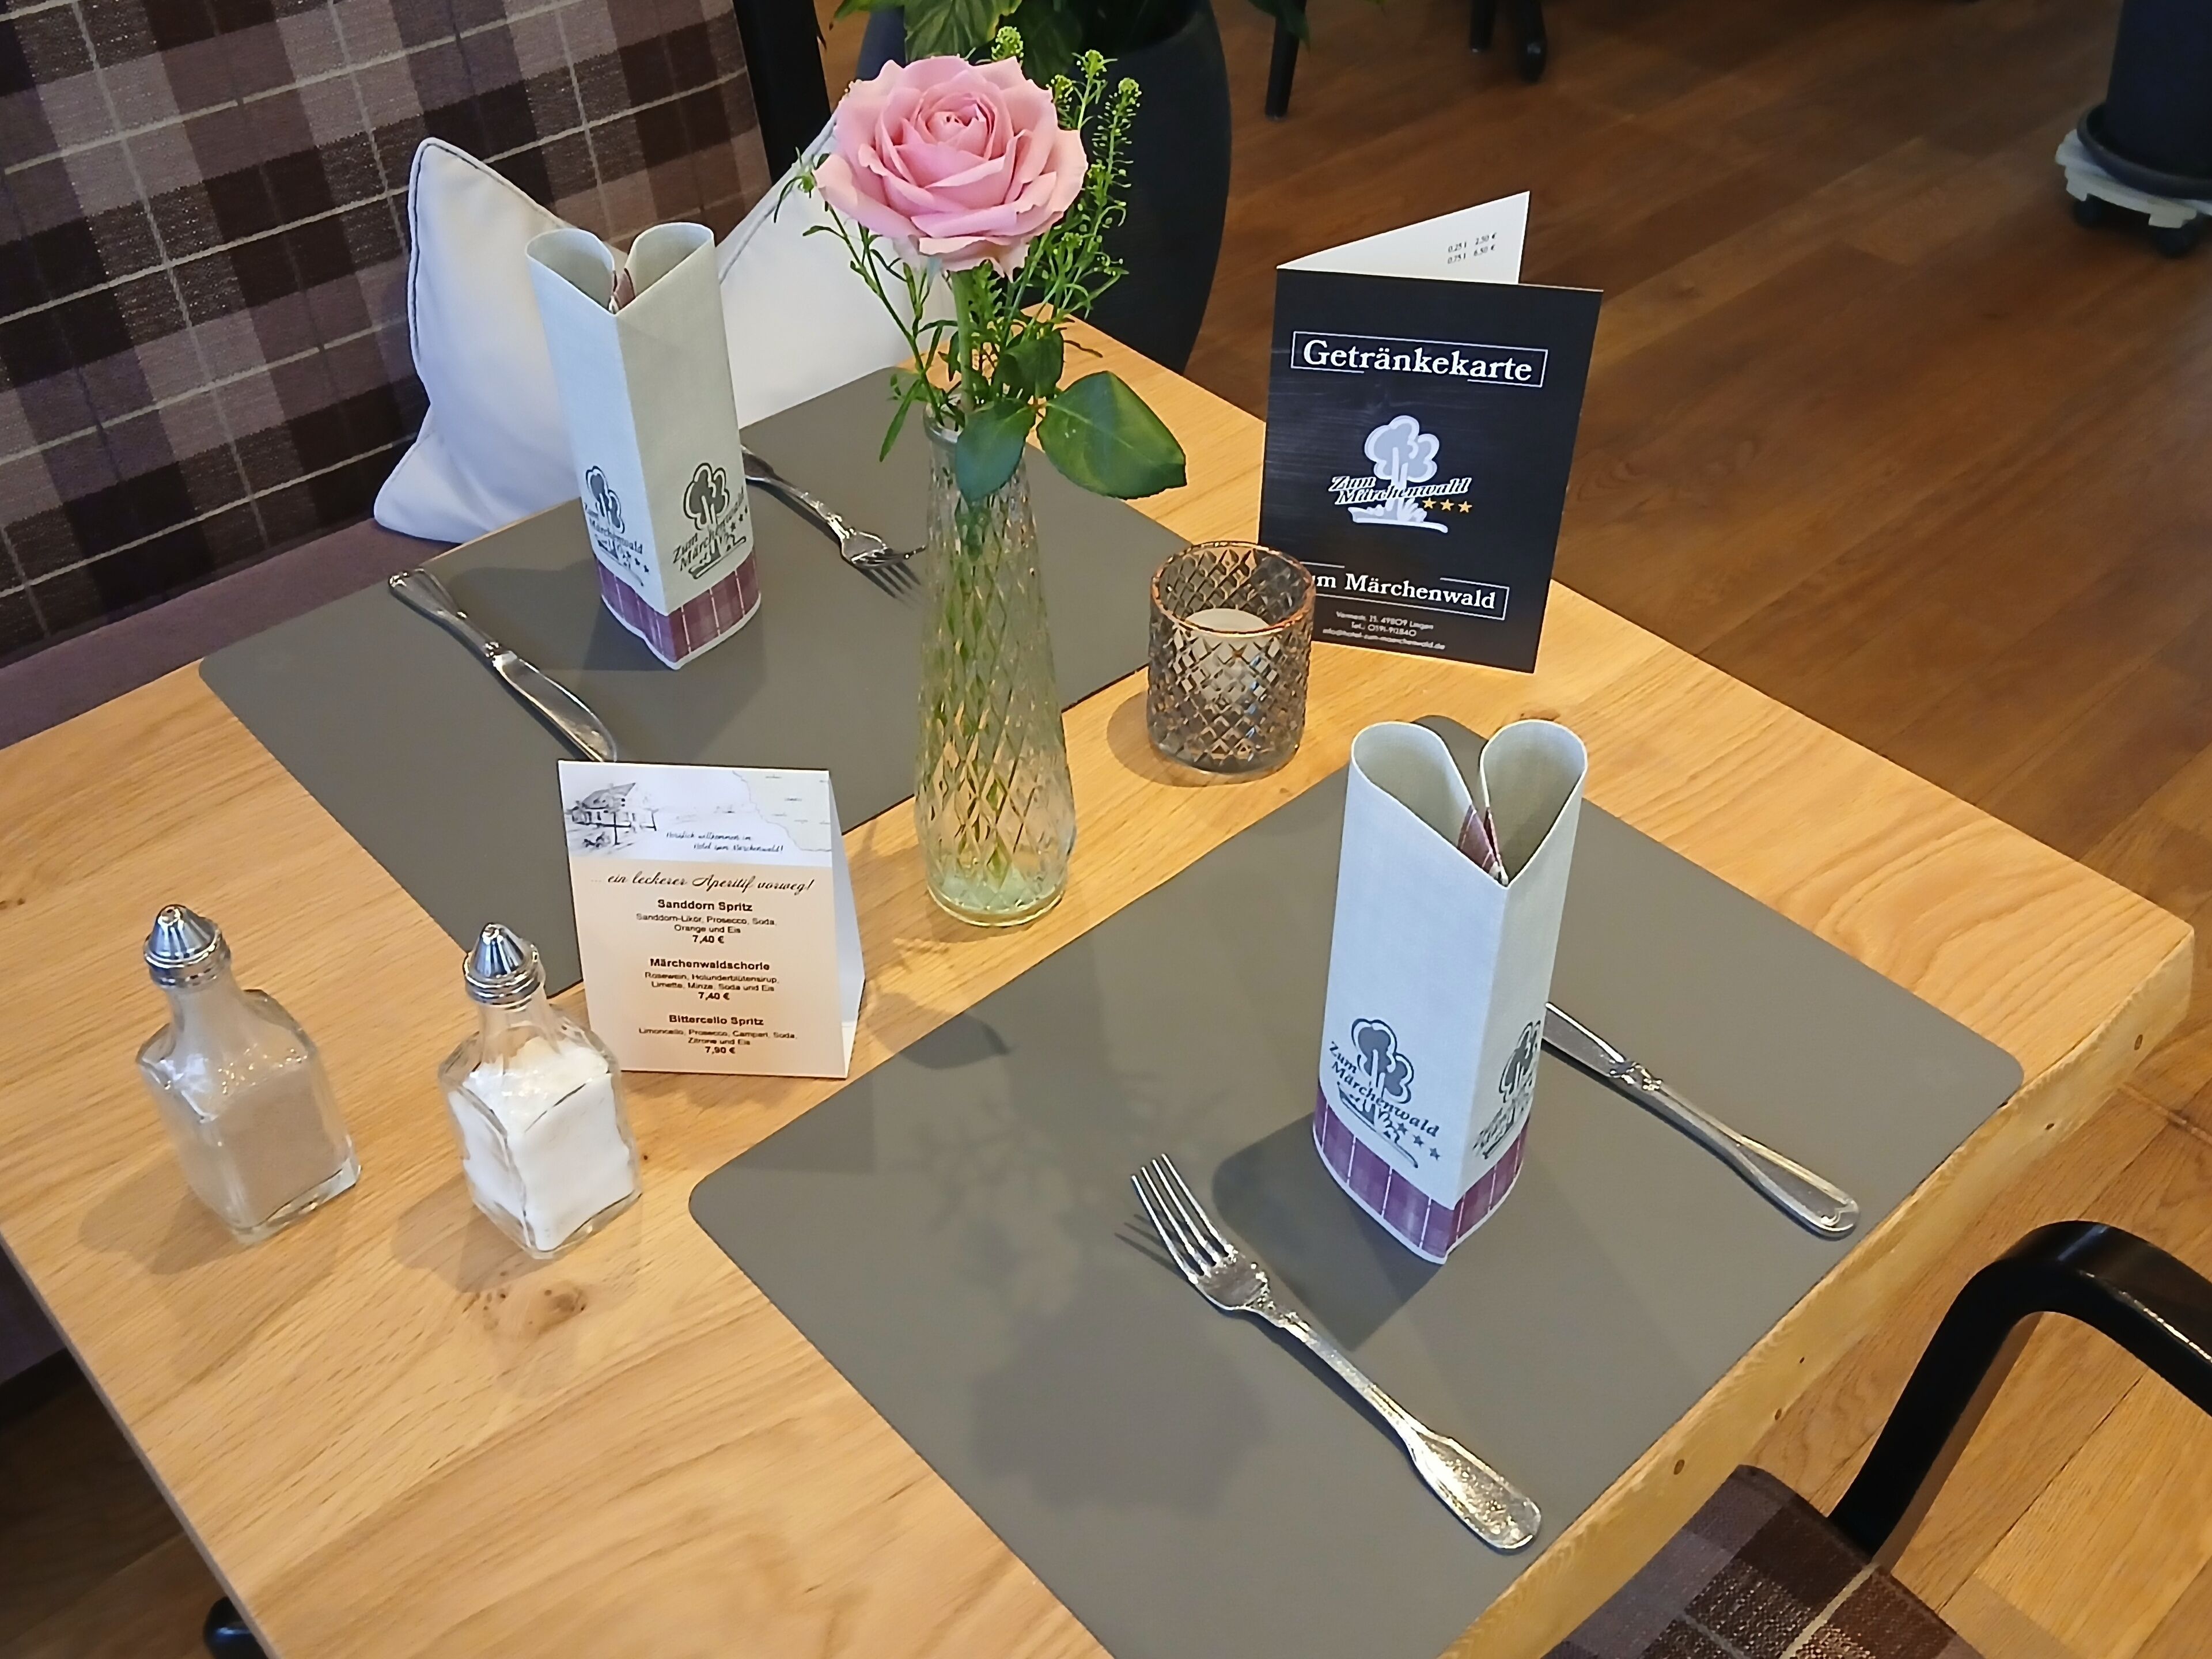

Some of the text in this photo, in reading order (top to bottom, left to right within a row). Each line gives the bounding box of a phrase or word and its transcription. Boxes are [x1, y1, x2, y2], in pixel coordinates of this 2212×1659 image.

[1304, 340, 1532, 381] Getränkekarte
[1328, 476, 1377, 491] Zum
[1335, 478, 1472, 505] Märchenwald
[1344, 573, 1495, 609] Märchenwald
[608, 874, 627, 883] ein
[632, 871, 687, 886] leckerer
[692, 874, 755, 893] Aperitif
[757, 879, 815, 895] vorweg!
[657, 899, 753, 912] Sanddorn Spritz
[707, 916, 749, 925] Prosecco,
[674, 925, 706, 933] Orange
[692, 935, 714, 944] 7,40
[650, 959, 770, 970] Märchenwaldschorle
[698, 992, 720, 1001] 7,40
[669, 1015, 764, 1027] Bittercello Spritz
[704, 1046, 727, 1054] 7,90
[1329, 1041, 1357, 1074] Zum
[1331, 1061, 1440, 1137] Märchenwald
